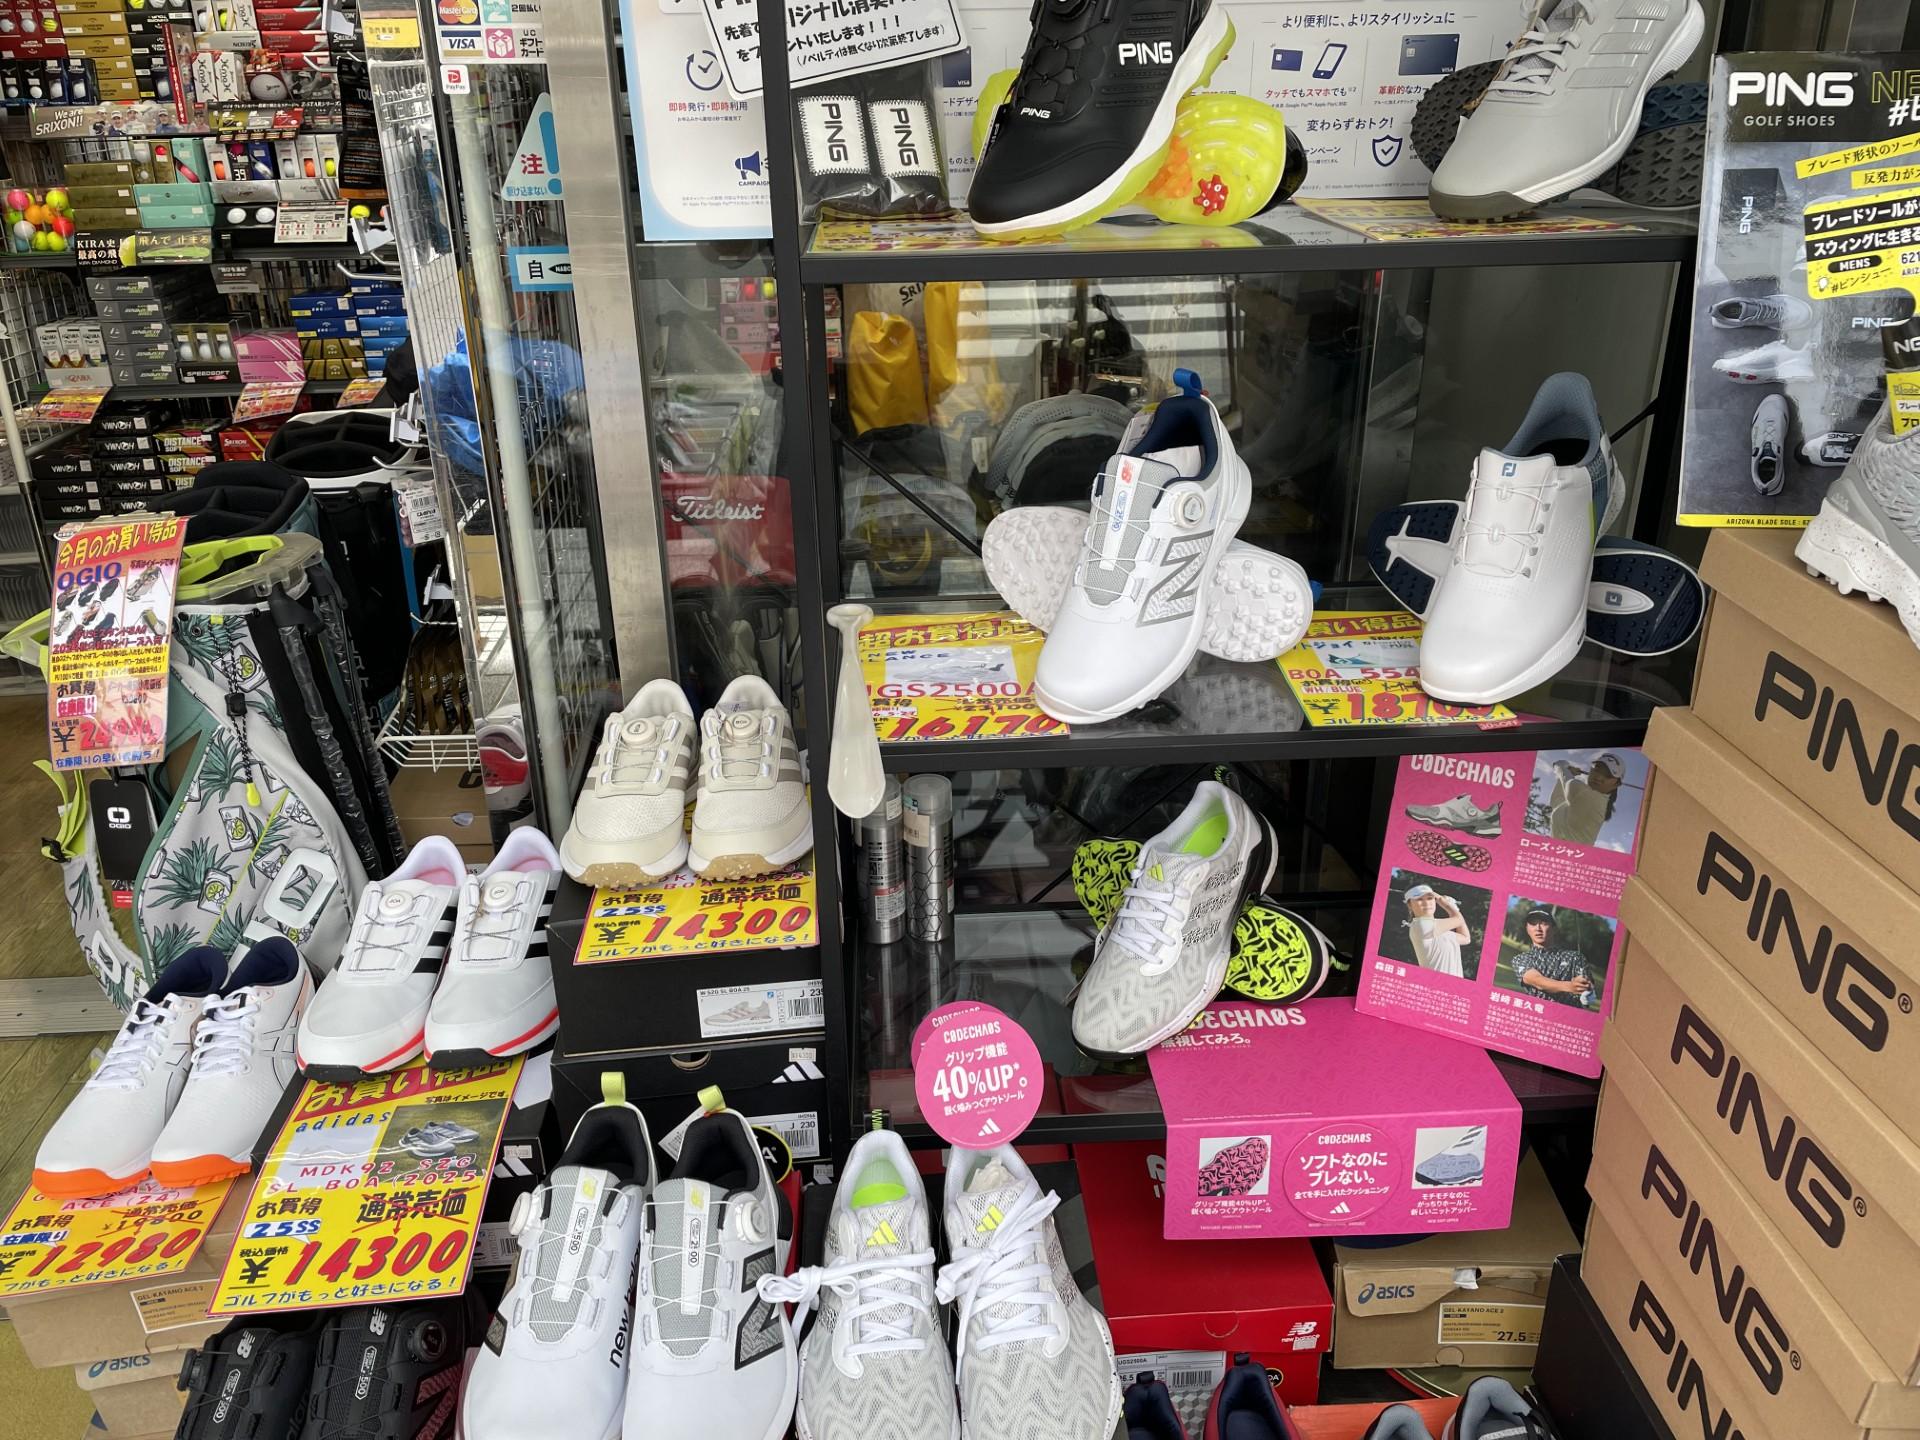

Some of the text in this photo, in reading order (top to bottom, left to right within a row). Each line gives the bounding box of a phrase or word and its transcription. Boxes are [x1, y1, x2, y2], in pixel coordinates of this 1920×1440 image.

[439, 7, 477, 15] MasterCard
[511, 4, 541, 13] 2回払い
[1281, 11, 1456, 29] より便利に、よりスタイリッシュに
[725, 22, 760, 40] 先着で
[449, 38, 476, 49] VISA
[1118, 41, 1173, 66] PING
[1728, 71, 1854, 107] PING
[54, 108, 84, 121] We are
[668, 101, 748, 112] 即時発行・即時利用
[1020, 107, 1051, 119] PING
[35, 115, 85, 137] SRIXON!!
[1743, 115, 1836, 127] GOLF SHOES
[822, 103, 849, 163] PING
[889, 107, 920, 167] PING
[521, 153, 545, 175] 注
[506, 186, 548, 197] 駆け込まない
[1739, 195, 1754, 234] PING
[529, 260, 544, 280] 自
[1840, 257, 1871, 271] MENS
[164, 437, 202, 447] DISTANCE
[168, 458, 207, 468] DISTANCE
[671, 495, 766, 522] Titleist
[59, 520, 178, 569] 今月のお買い得品
[57, 562, 122, 591] OGIO
[1288, 668, 1343, 680] BOA
[57, 680, 96, 698] お買得
[887, 714, 1064, 740] 16170
[1520, 838, 1585, 858] ローズ・ジャン
[602, 893, 663, 907] お買得
[643, 906, 812, 944] 14300
[587, 934, 810, 959] ゴルフがもっと好きになる！
[1697, 831, 1897, 1052] PING
[945, 1041, 1008, 1067] グリップ機能
[295, 1109, 392, 1133] adidas
[800, 1121, 815, 1129] 230
[1670, 1003, 1853, 1249] PING
[1300, 1151, 1388, 1170] ソフトなのに
[325, 1175, 379, 1191] BOA
[1308, 1168, 1375, 1187] ブレない。
[1294, 1186, 1390, 1200] 全てを手に入れたクッショニング
[1421, 1191, 1471, 1201] モチモチなのに
[61, 1200, 115, 1211] ACE
[256, 1197, 323, 1219] お買得
[357, 1187, 469, 1224] 通常売価
[1410, 1206, 1478, 1217] 新しいニットアッパー
[12, 1214, 76, 1232] お買得
[252, 1220, 321, 1238] 25SS
[27, 1227, 202, 1278] 12980
[283, 1229, 469, 1286] 14300
[1641, 1144, 1790, 1396] PING
[223, 1276, 457, 1308] ゴルフがもっと好きになる！
[1376, 1285, 1415, 1300] asics
[1497, 1331, 1527, 1342] 27.5
[109, 1353, 151, 1371] asics
[1629, 1280, 1746, 1440] PIN
